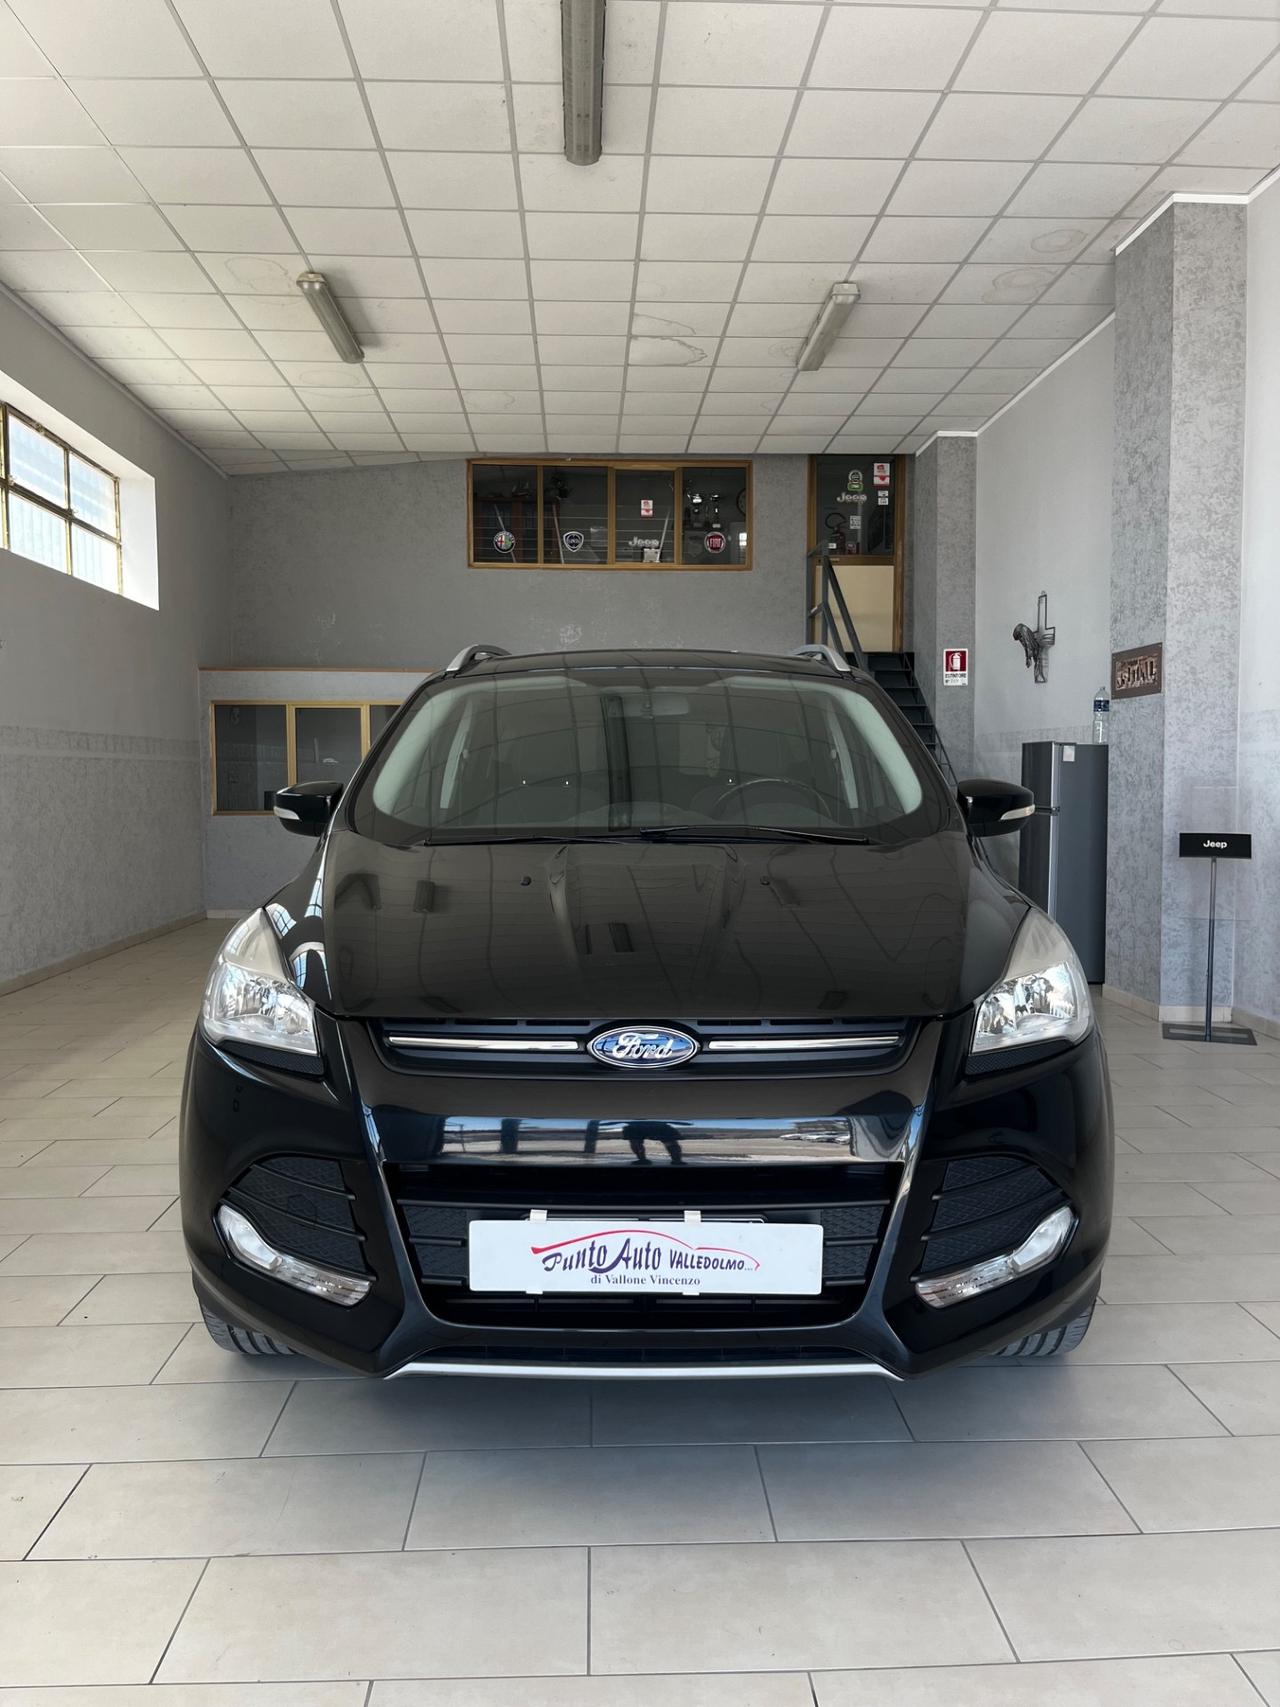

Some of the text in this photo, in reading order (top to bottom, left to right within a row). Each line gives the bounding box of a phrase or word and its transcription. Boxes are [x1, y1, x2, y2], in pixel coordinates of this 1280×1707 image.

[1203, 840, 1227, 849] Jeep
[612, 1032, 674, 1059] Ford
[542, 1240, 608, 1272] Punto
[588, 1238, 662, 1274] Auto
[590, 1275, 701, 1286] di Vallone Vincenzo
